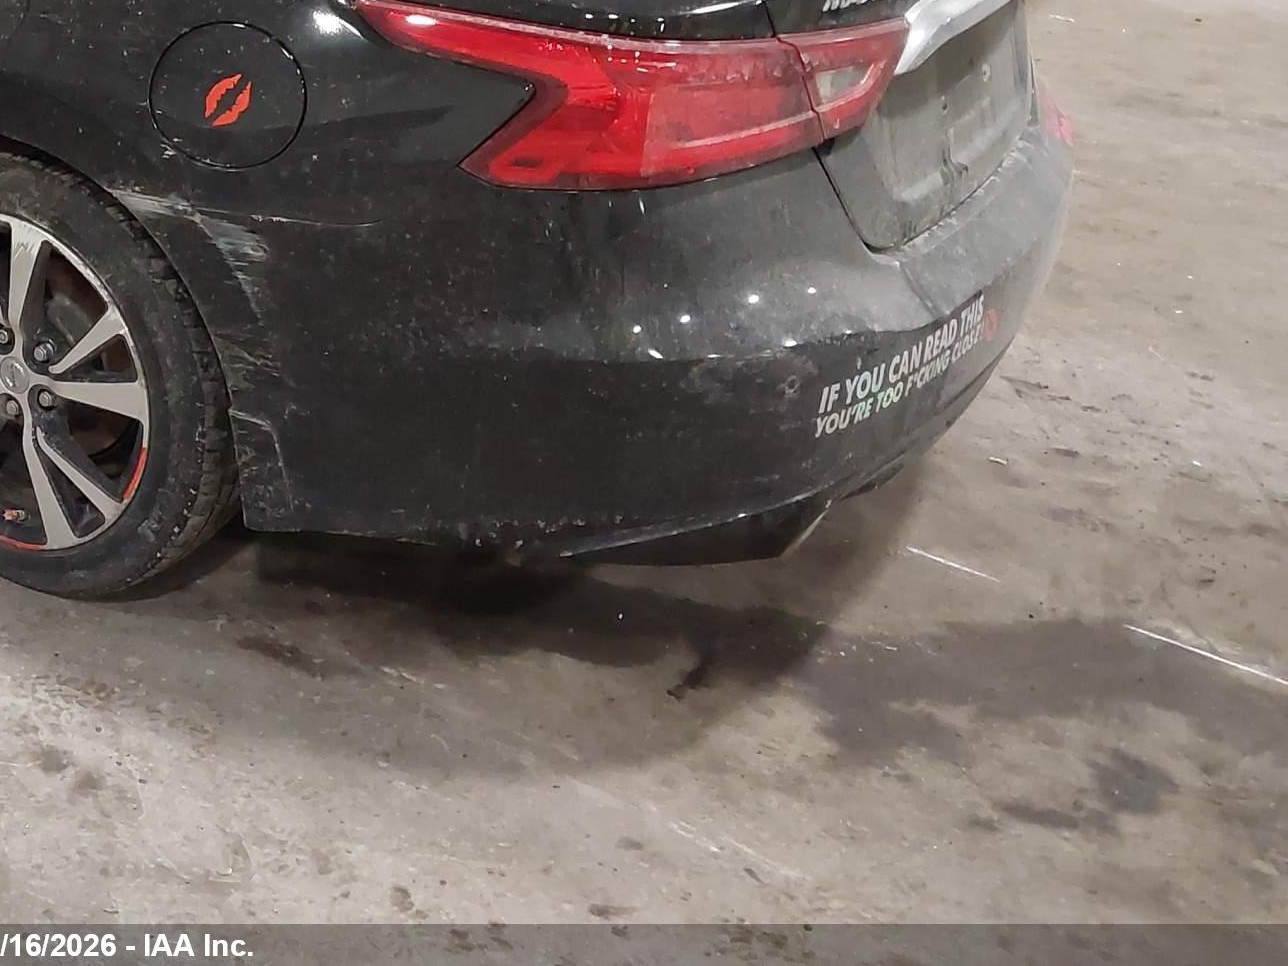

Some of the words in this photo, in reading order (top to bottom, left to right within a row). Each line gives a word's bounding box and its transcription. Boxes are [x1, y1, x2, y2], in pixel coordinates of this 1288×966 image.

[818, 382, 841, 414] IF
[845, 363, 886, 405] YOU
[889, 341, 923, 383] CAN
[923, 318, 958, 364] READ
[960, 294, 985, 337] THIS
[815, 398, 874, 438] YOU'RE
[875, 381, 904, 413] TOO
